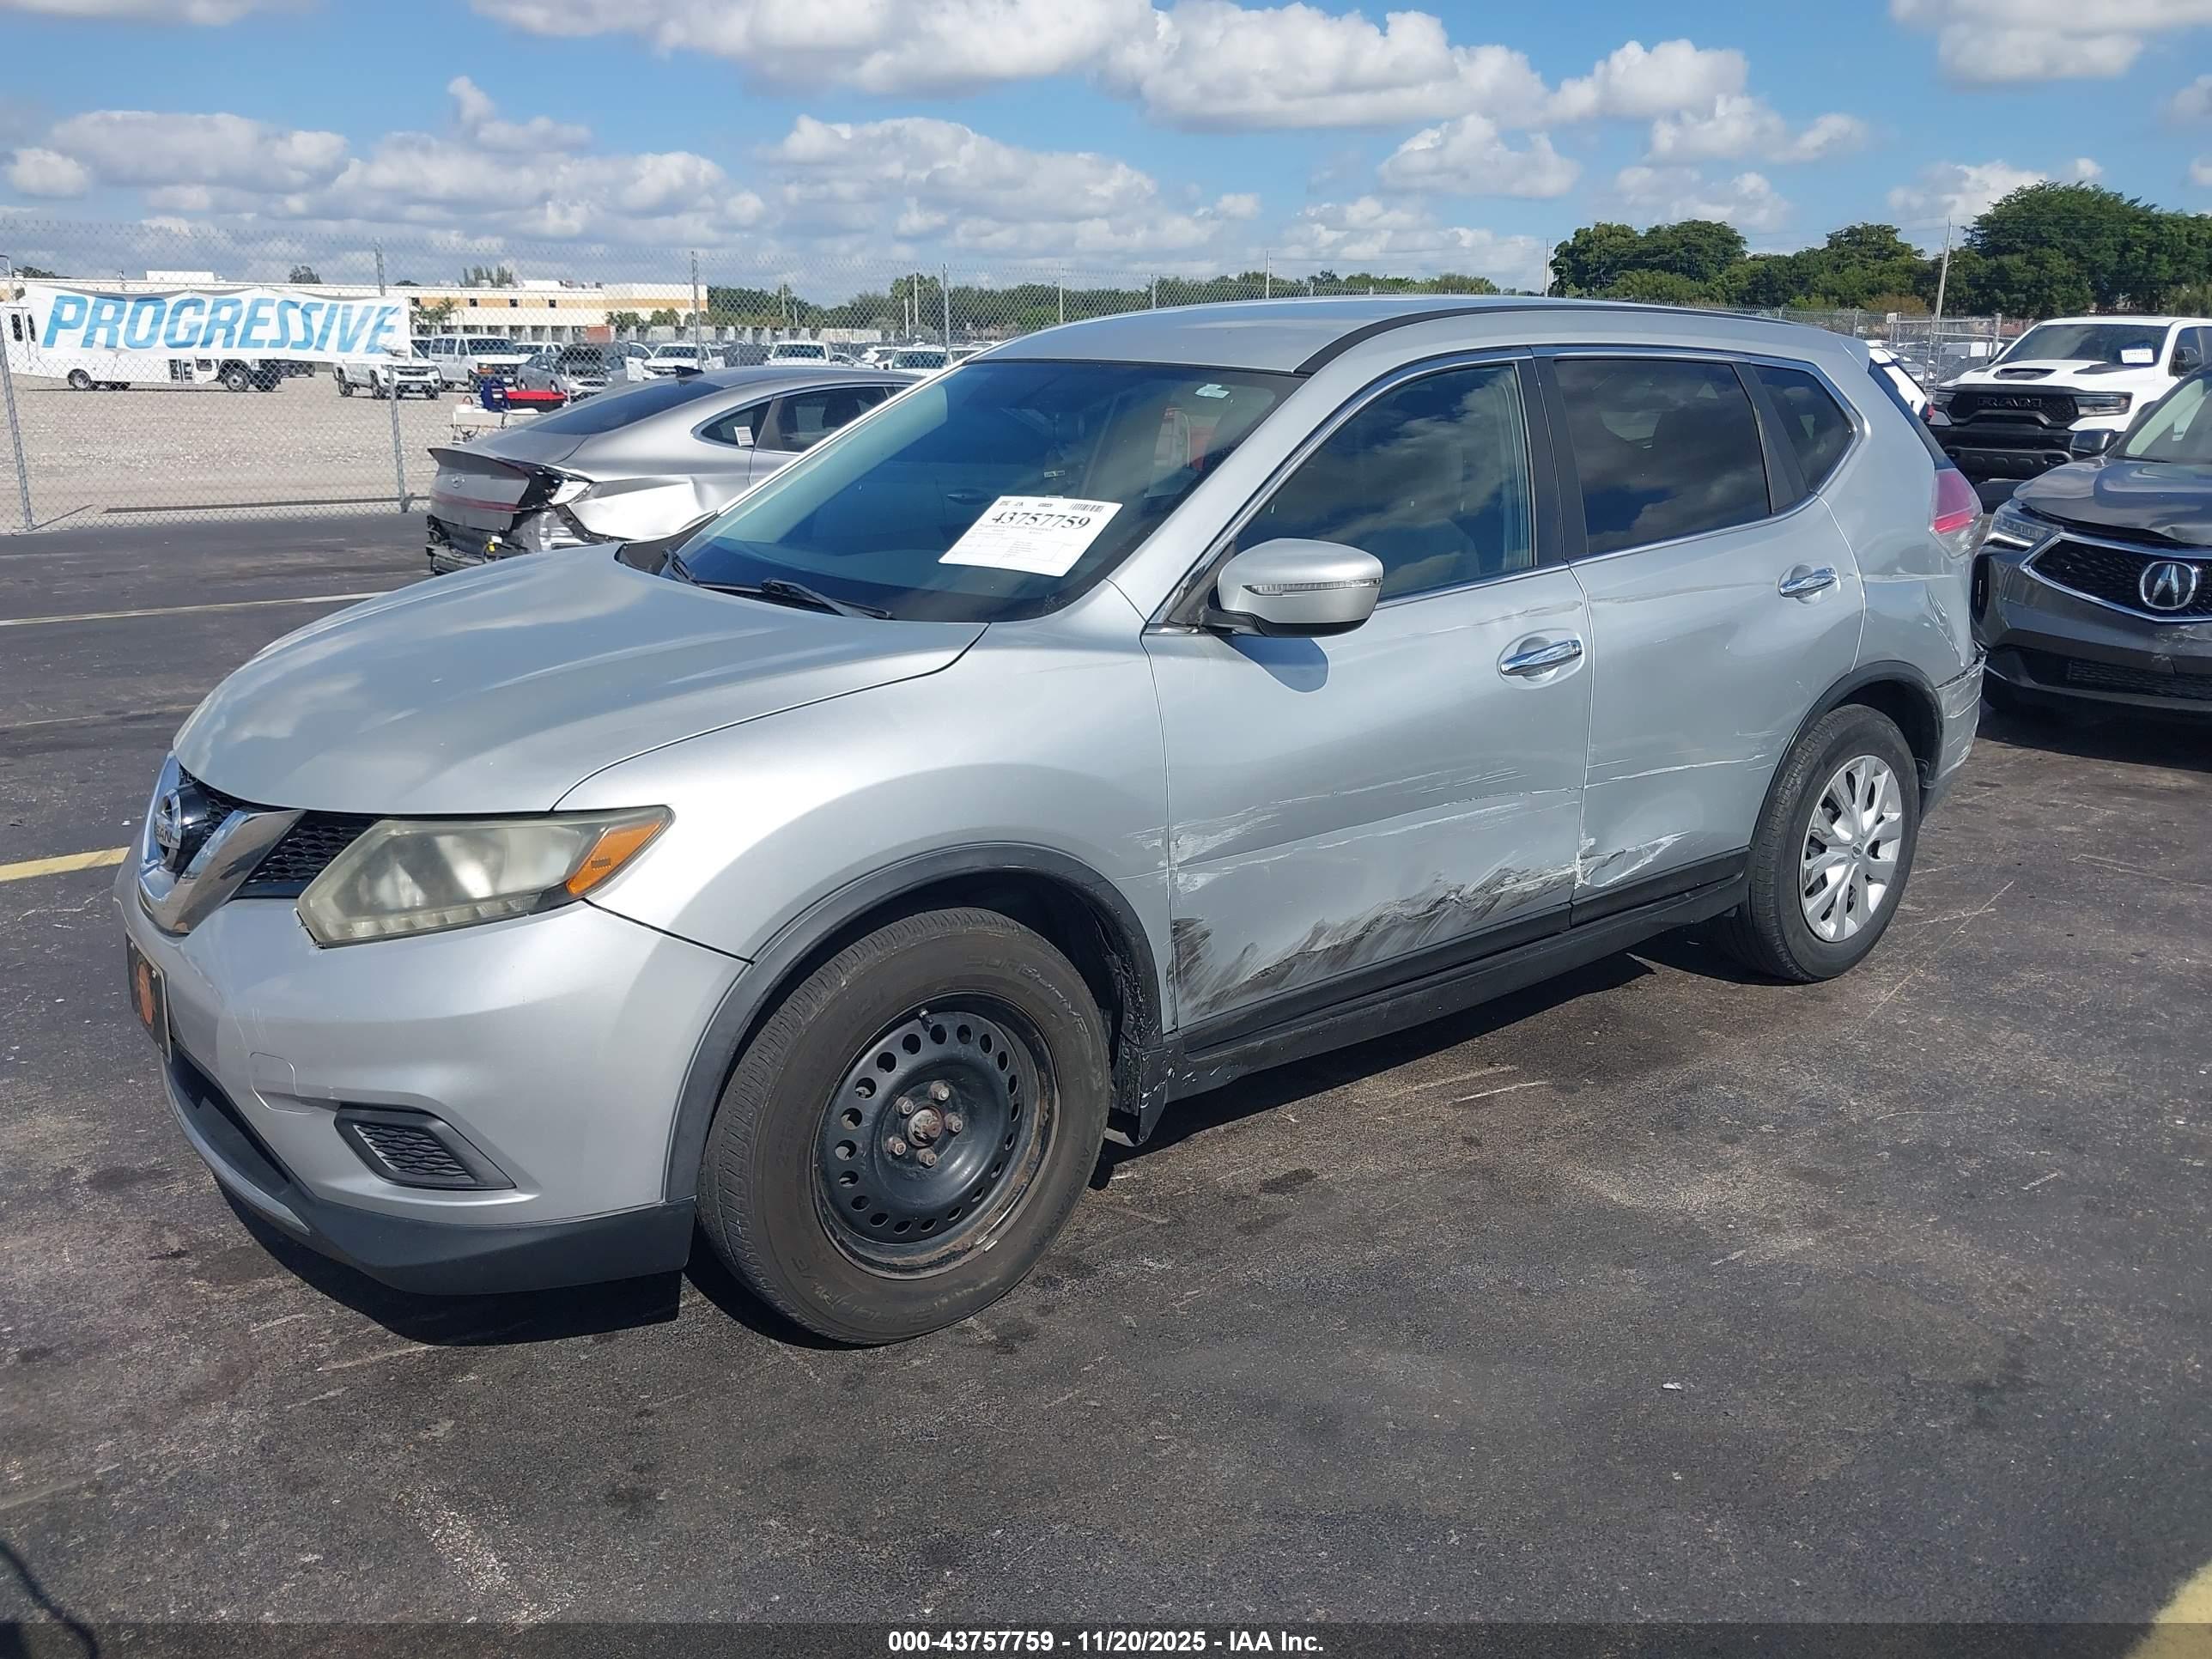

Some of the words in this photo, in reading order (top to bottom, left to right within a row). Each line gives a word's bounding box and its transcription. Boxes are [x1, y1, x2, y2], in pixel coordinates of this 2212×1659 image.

[40, 295, 400, 354] PROGRESSIVE
[1978, 397, 2042, 407] RAM
[992, 511, 1091, 530] 43757759
